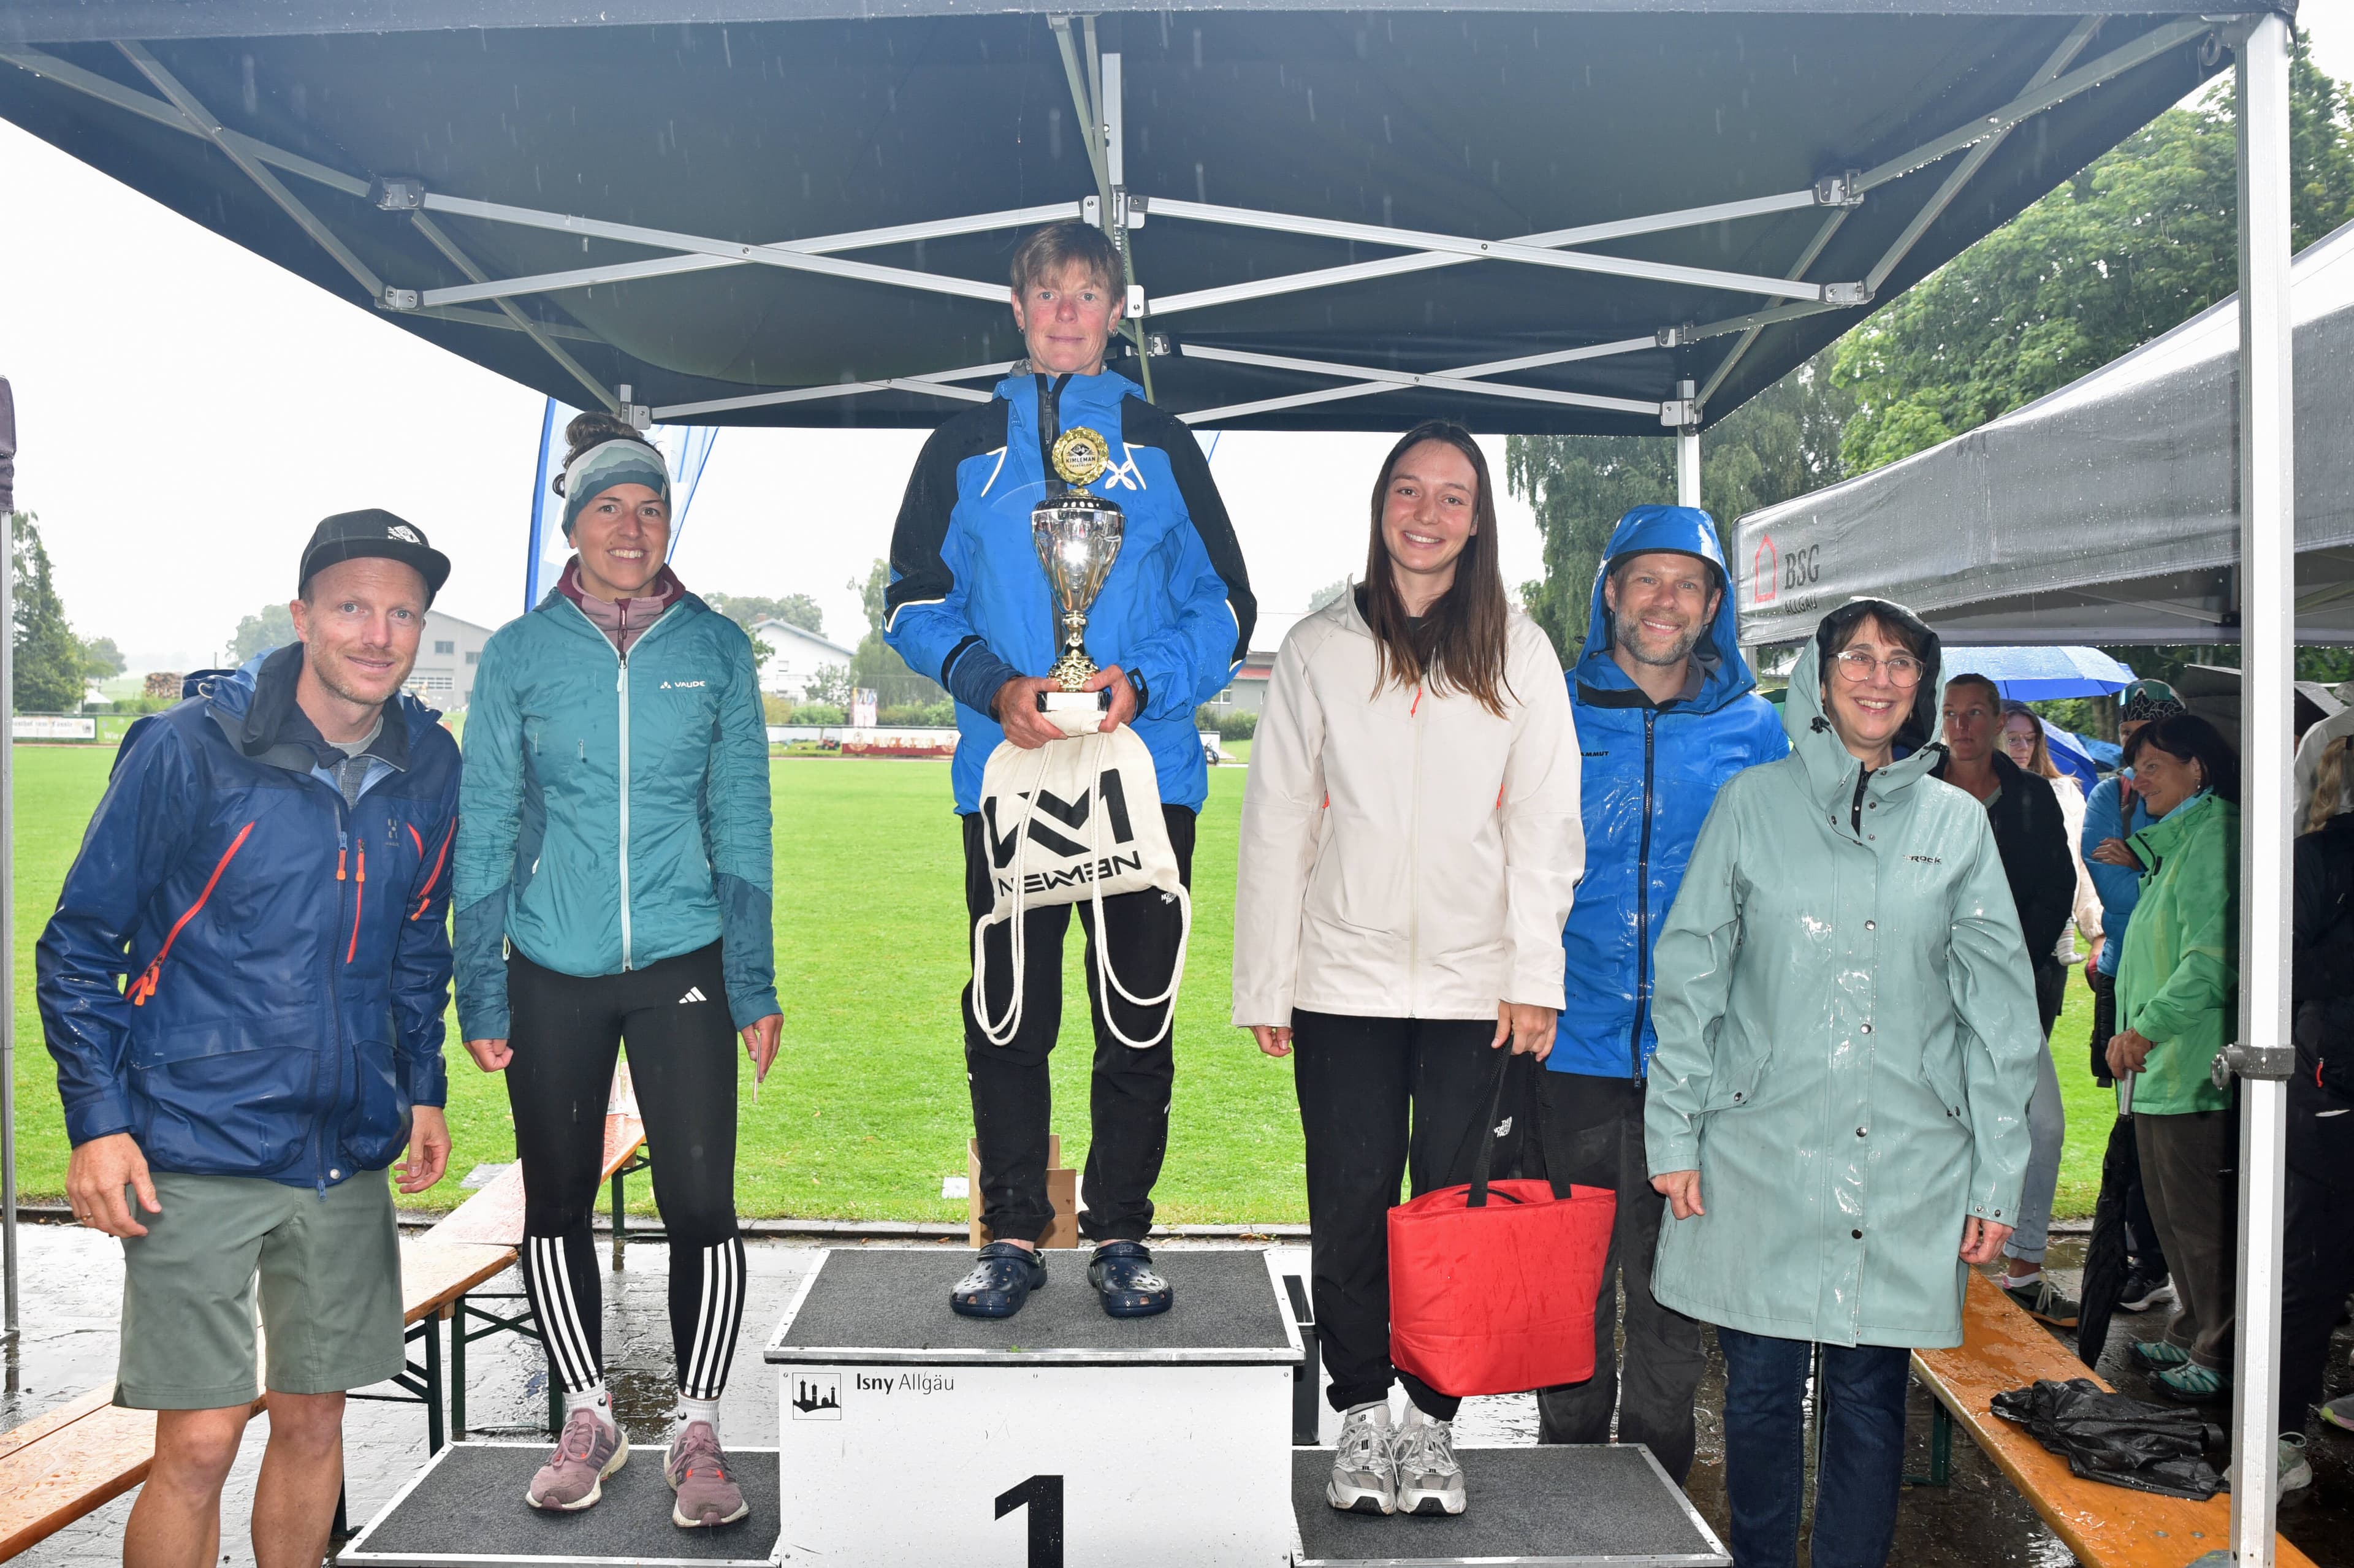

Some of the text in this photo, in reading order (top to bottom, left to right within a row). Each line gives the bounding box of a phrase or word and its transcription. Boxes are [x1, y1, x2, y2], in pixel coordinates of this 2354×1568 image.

[1785, 544, 1819, 590] BSG
[857, 1373, 954, 1395] Isny Allgäu
[994, 1475, 1064, 1568] 1
